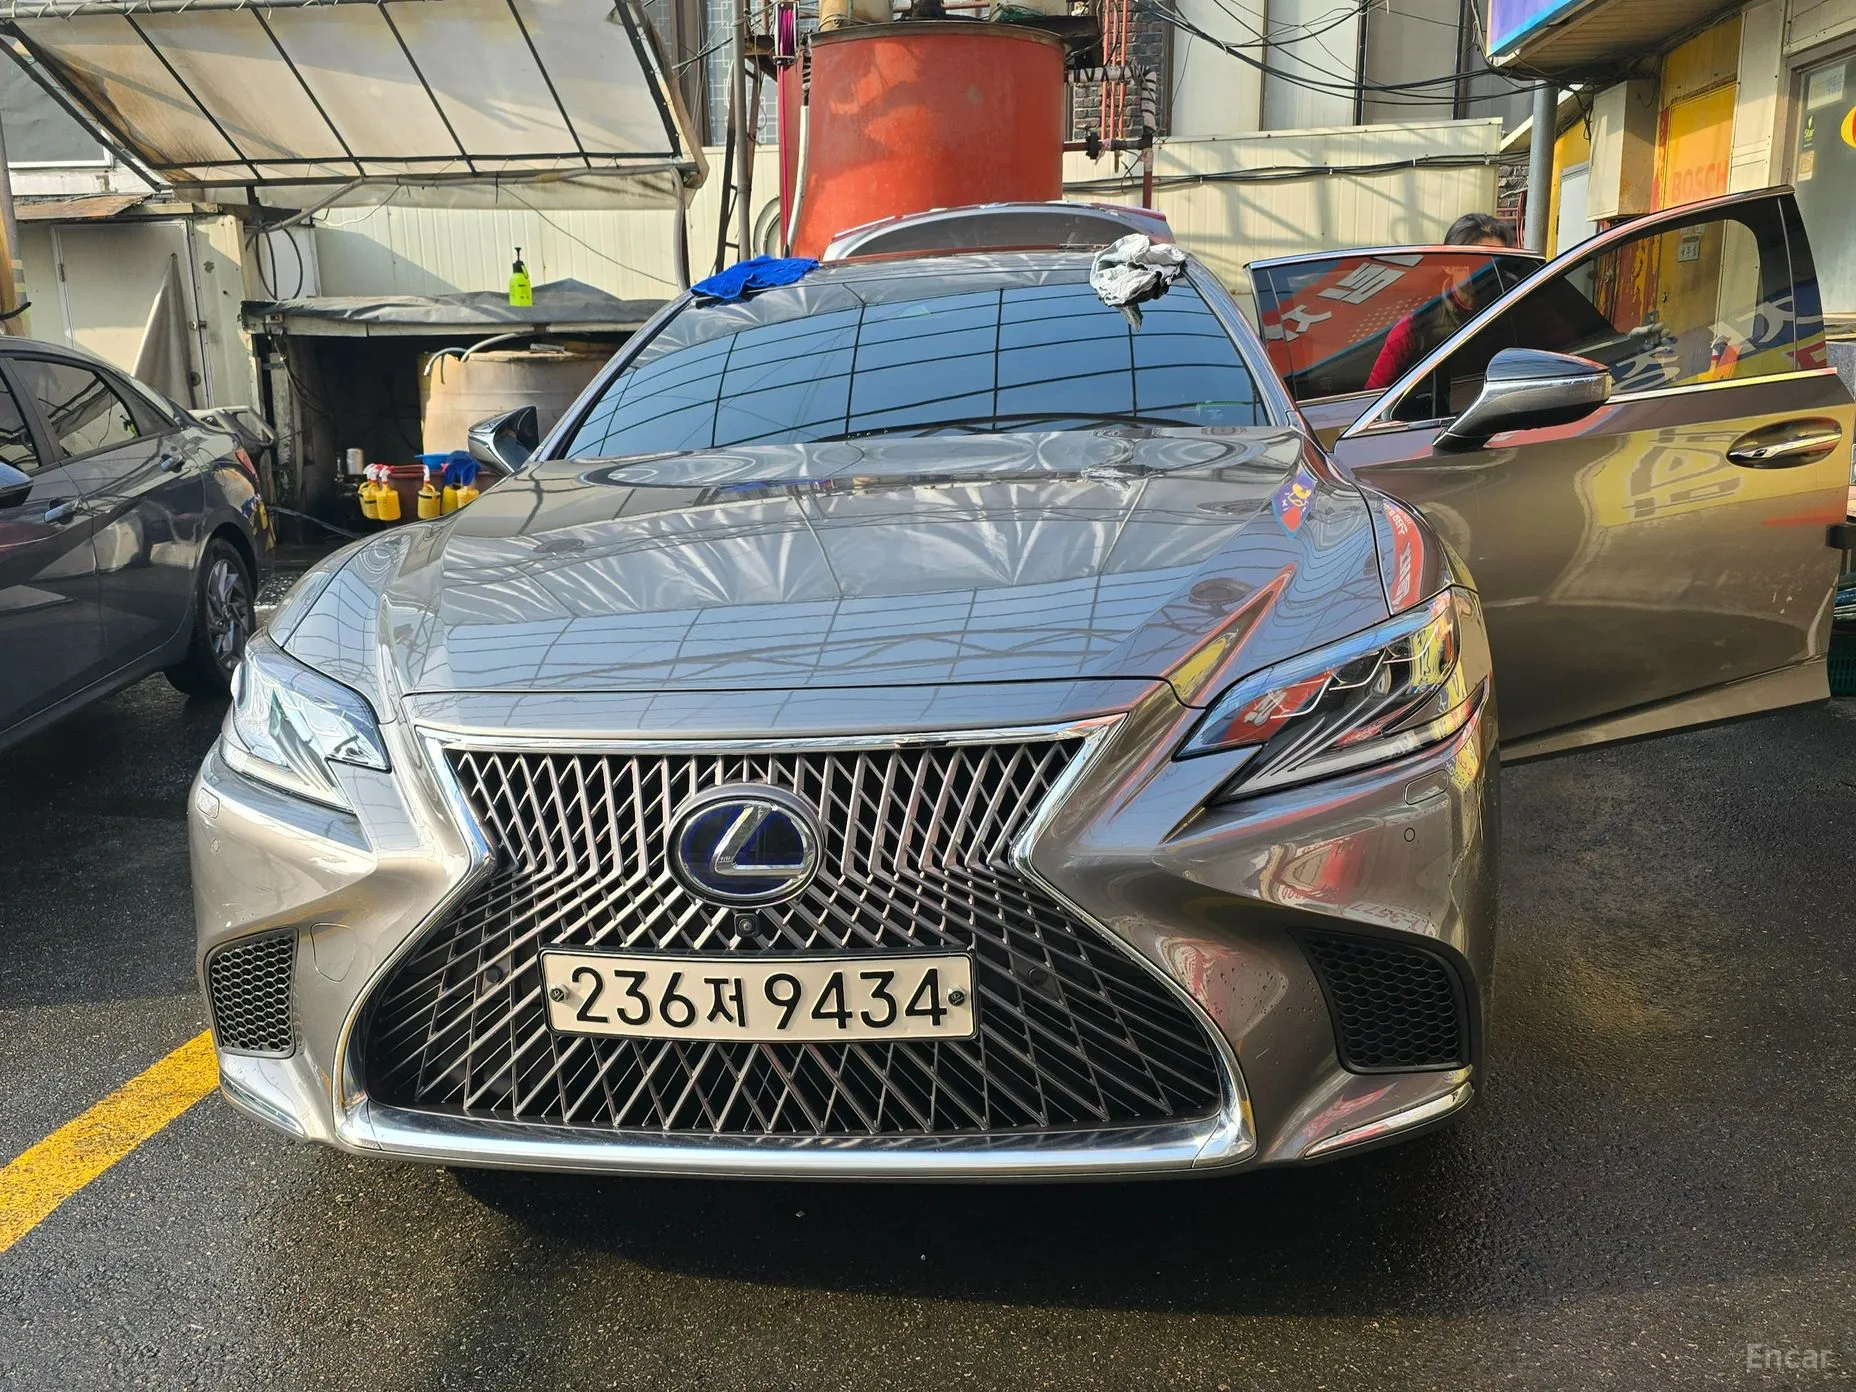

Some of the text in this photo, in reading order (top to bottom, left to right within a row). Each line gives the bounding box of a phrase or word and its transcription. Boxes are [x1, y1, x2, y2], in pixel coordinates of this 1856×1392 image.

[1671, 160, 1729, 203] BOSCH
[572, 967, 948, 1029] 236저 9434
